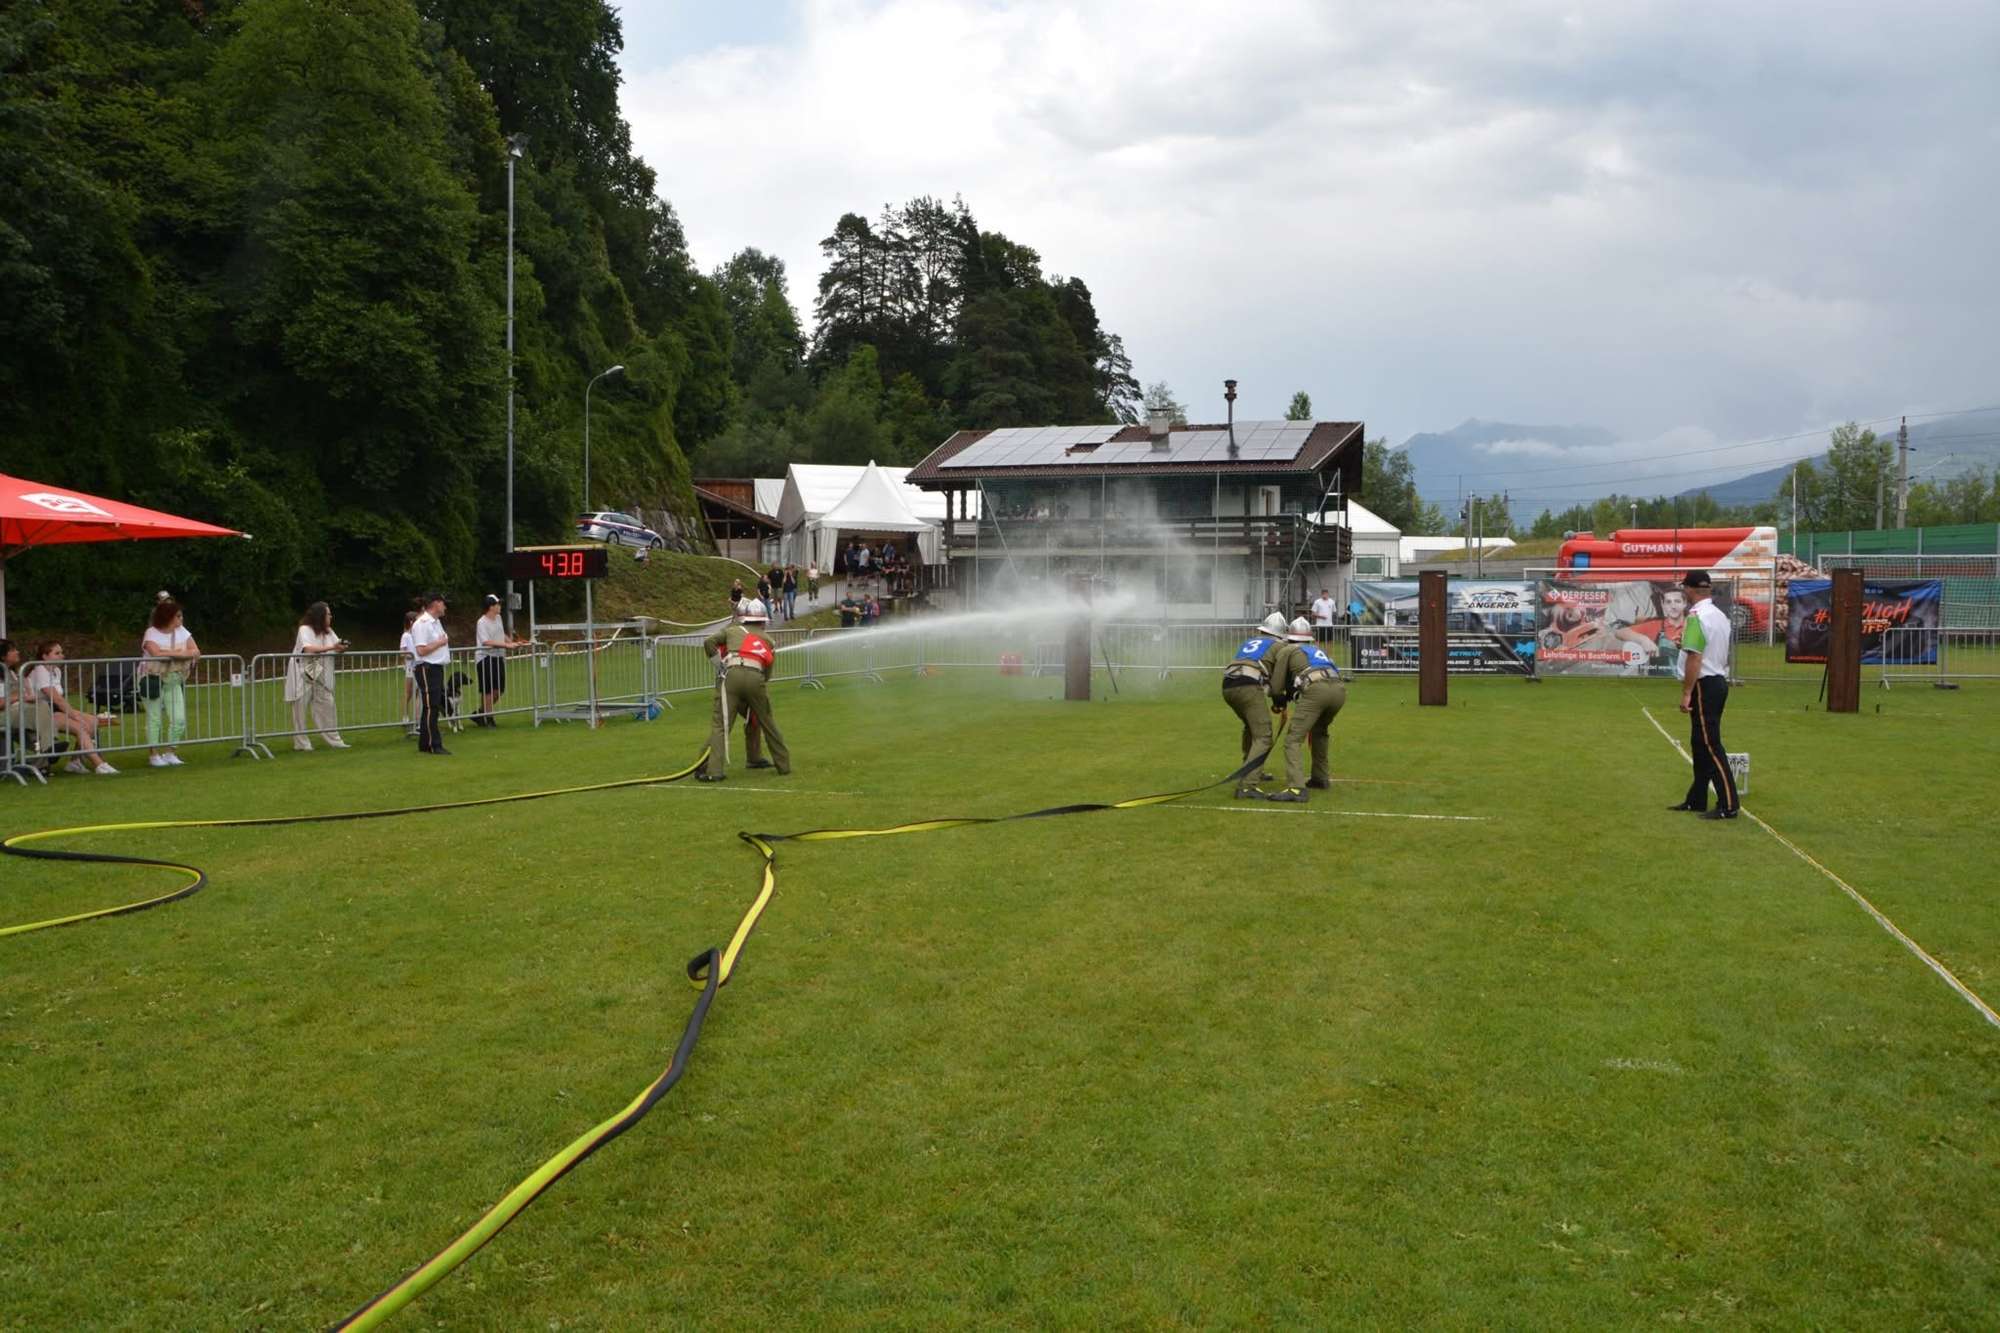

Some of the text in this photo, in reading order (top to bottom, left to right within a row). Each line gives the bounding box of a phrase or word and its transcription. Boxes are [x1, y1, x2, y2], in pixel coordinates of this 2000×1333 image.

[1622, 543, 1683, 553] GUTMANN
[542, 553, 583, 576] 43.8
[1561, 590, 1607, 601] DERFESER
[1243, 640, 1262, 653] 3
[1314, 649, 1329, 662] 4
